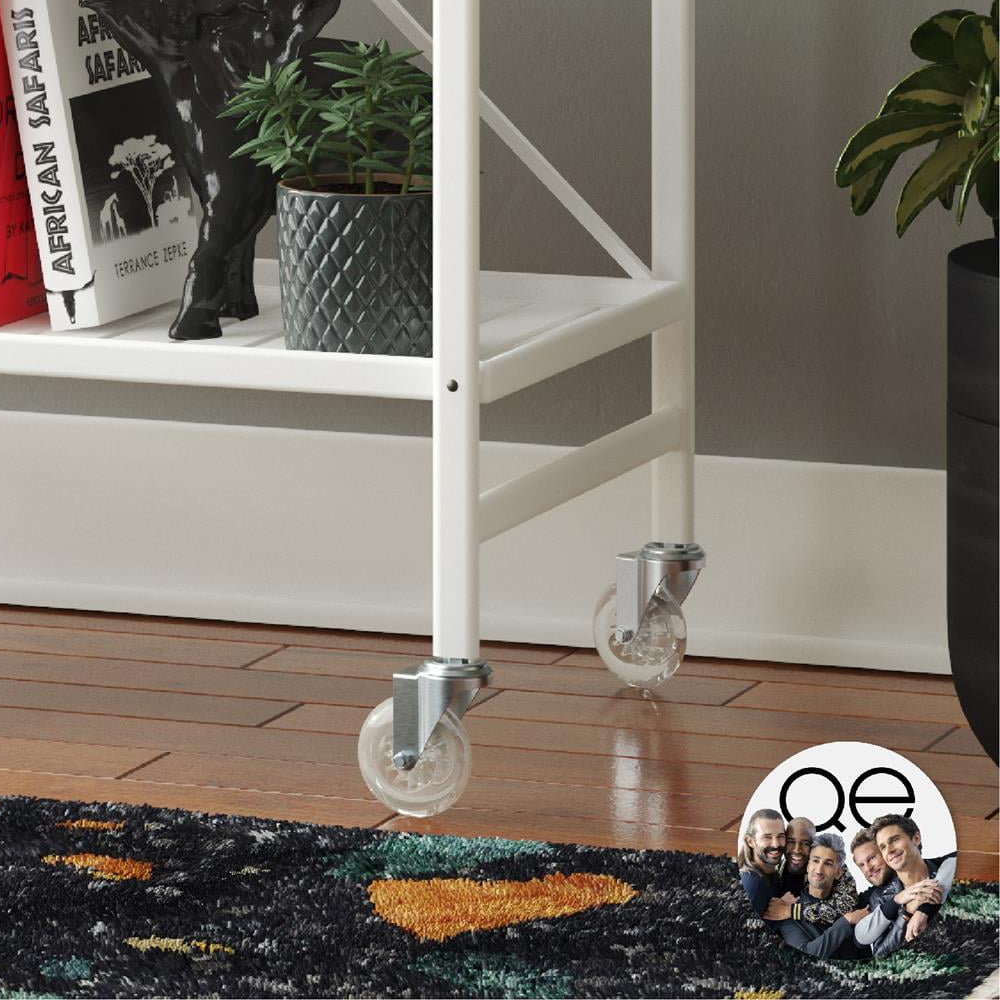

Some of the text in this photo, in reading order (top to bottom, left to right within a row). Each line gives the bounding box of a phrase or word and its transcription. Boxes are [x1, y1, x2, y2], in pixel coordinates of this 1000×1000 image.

[11, 7, 52, 129] SAFARIS
[86, 47, 147, 86] SAFAR
[32, 141, 76, 276] AFRICAN
[114, 241, 188, 279] TERRANCE ZEPKE
